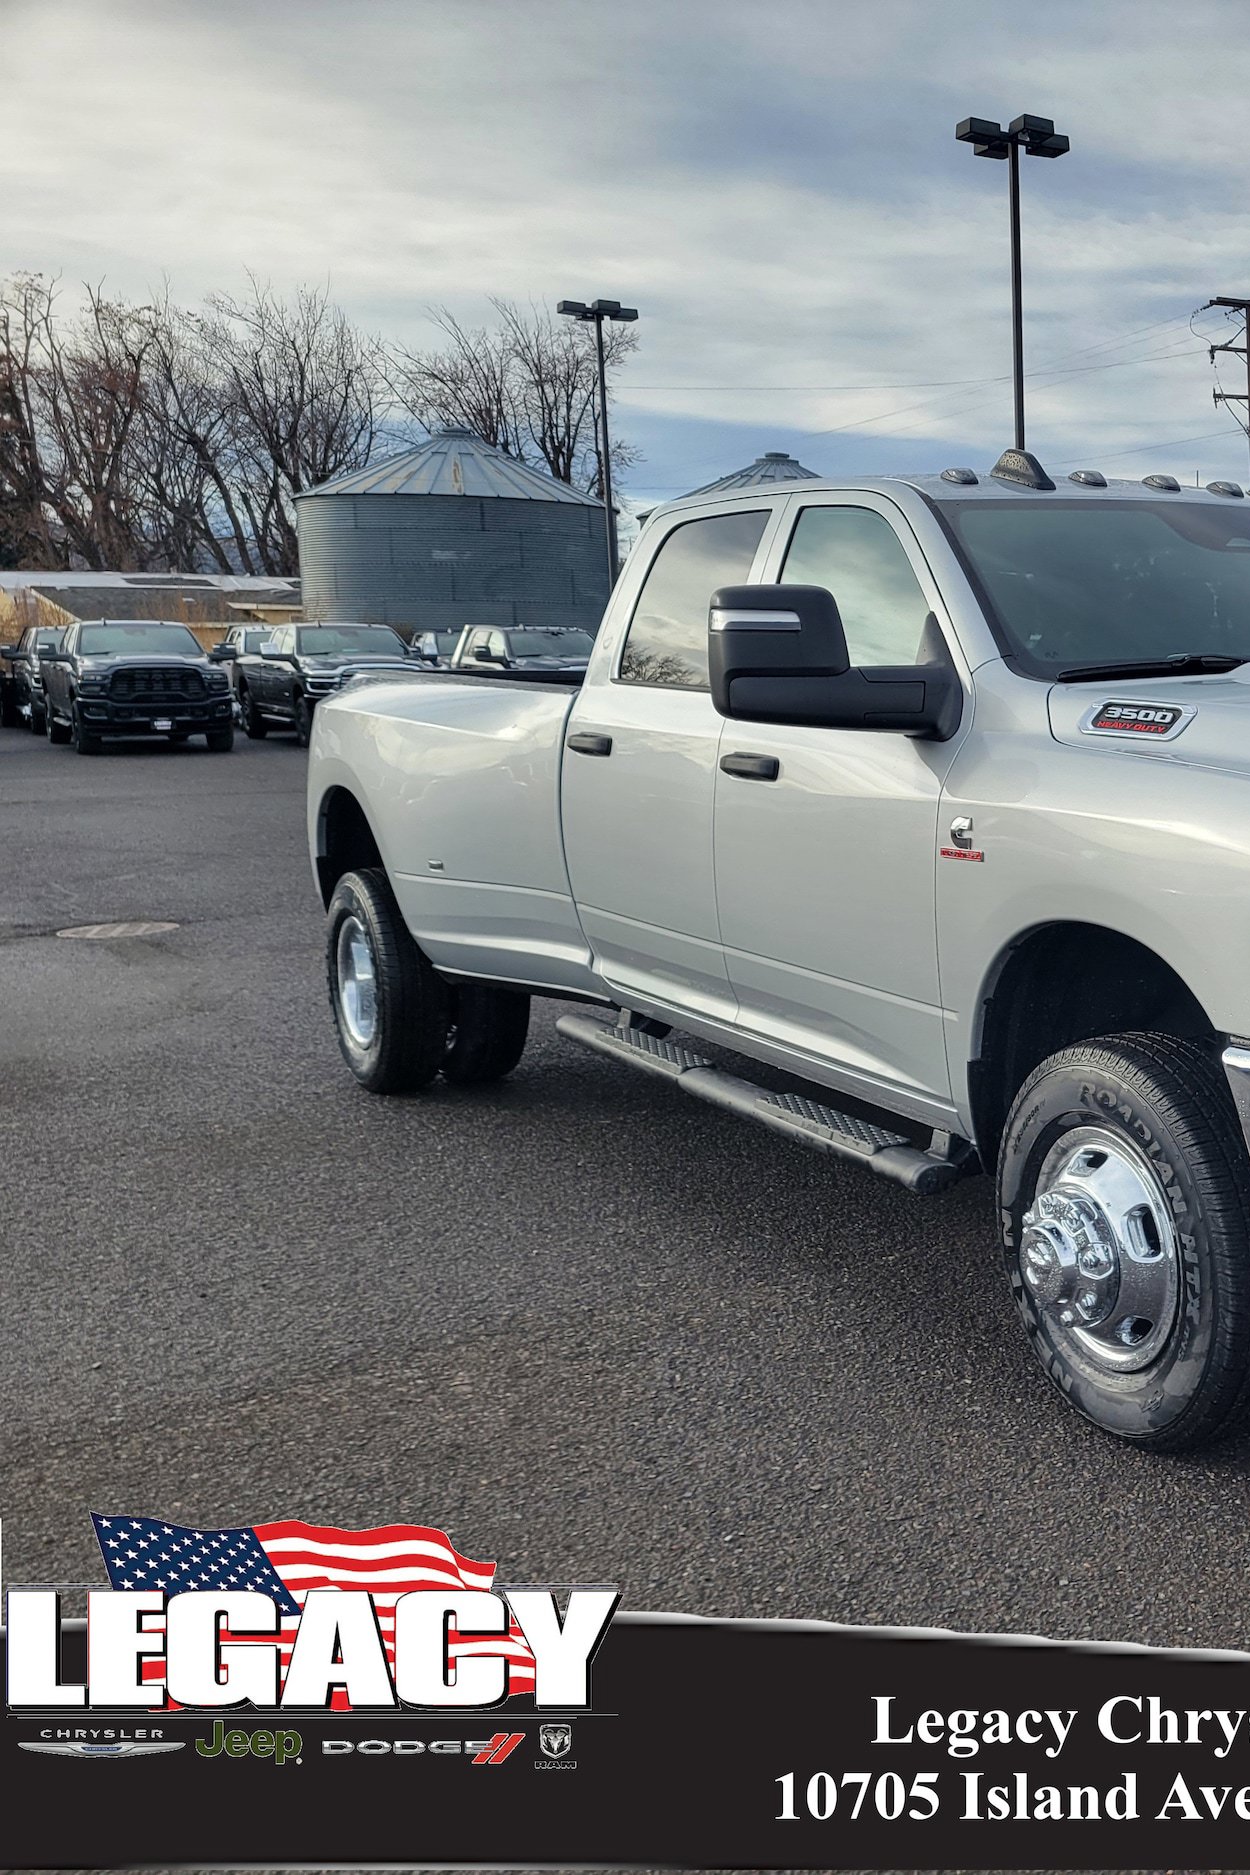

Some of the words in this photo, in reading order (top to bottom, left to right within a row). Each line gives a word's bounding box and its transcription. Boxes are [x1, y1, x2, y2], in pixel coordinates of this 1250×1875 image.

[1104, 707, 1174, 724] 3500
[1097, 721, 1133, 730] HEAVY
[1133, 724, 1166, 733] DUTY
[1079, 1082, 1188, 1214] ROADIAN
